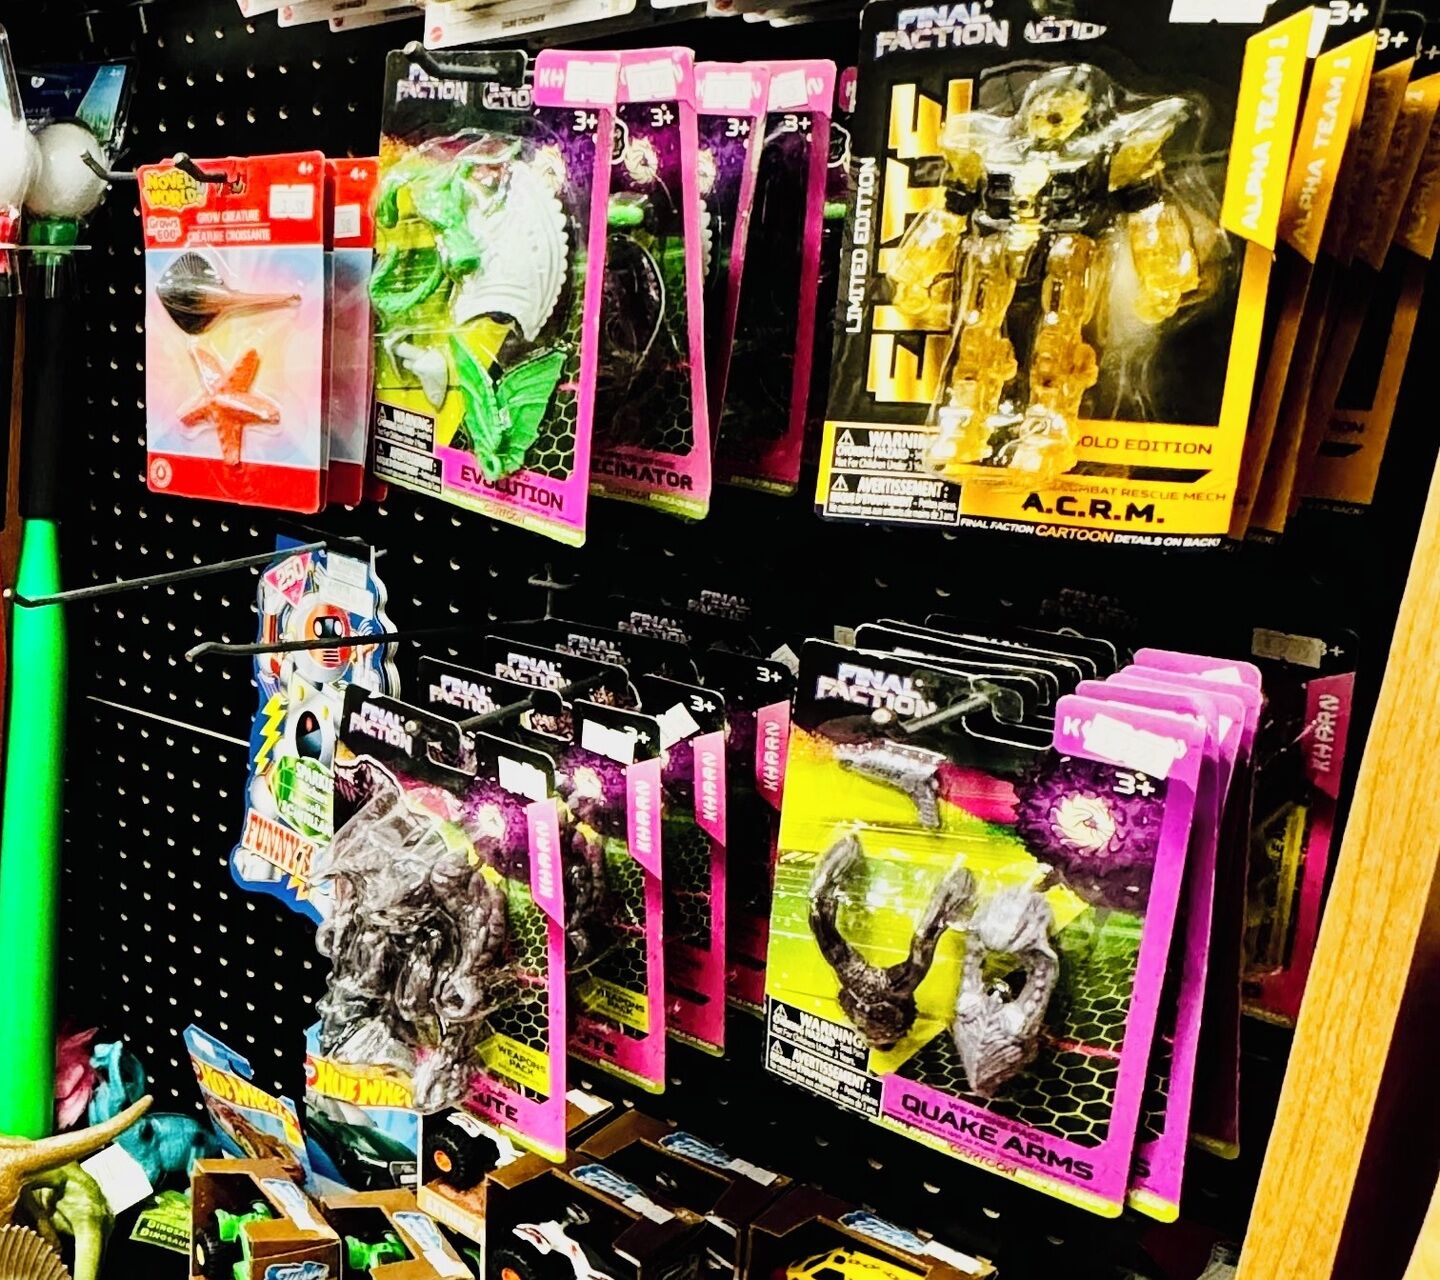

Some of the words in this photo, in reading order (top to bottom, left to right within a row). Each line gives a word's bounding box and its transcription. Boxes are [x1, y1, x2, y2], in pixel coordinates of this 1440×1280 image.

[898, 1, 994, 30] FINAL
[1328, 0, 1369, 26] 3+
[874, 20, 1010, 60] FACTION
[1376, 27, 1409, 51] 3+
[397, 79, 468, 108] FACTION
[1255, 55, 1286, 135] TEAM
[574, 111, 598, 131] 3+
[650, 105, 674, 127] 3+
[785, 115, 812, 133] 3+
[1313, 75, 1347, 150] TEAM
[726, 118, 751, 138] 3+
[349, 166, 368, 181] 4+
[1241, 140, 1273, 231] ALPHA
[147, 186, 200, 208] WORLD
[853, 157, 877, 246] EDITION
[846, 246, 869, 333] LIMITED
[1076, 435, 1120, 450] OLD
[1125, 438, 1213, 456] EDITION
[590, 464, 694, 491] ECIMATOR
[1021, 491, 1166, 525] A.C.R.M.
[1121, 488, 1179, 501] RESCUE
[1183, 491, 1227, 502] MECH
[960, 518, 989, 530] FINAL
[990, 521, 1035, 535] FACTION
[1035, 524, 1114, 544] CARTOON
[1114, 534, 1163, 547] DETAILS
[1163, 536, 1184, 548] ON
[275, 560, 305, 590] 250
[495, 663, 572, 690] FACTION
[506, 652, 562, 675] FINAL
[756, 667, 783, 685] 3+
[440, 674, 492, 703] FINAL
[837, 663, 923, 698] FINAL
[691, 695, 717, 713] 3+
[814, 675, 936, 720] FACTION
[360, 701, 406, 732] FINAL
[348, 713, 414, 757] FACTION
[1112, 770, 1156, 799] 3+
[497, 1044, 548, 1074] WEAPONS
[509, 1058, 536, 1076] PACK
[901, 1092, 999, 1147] QUAKE
[1001, 1138, 1095, 1182] ARMS
